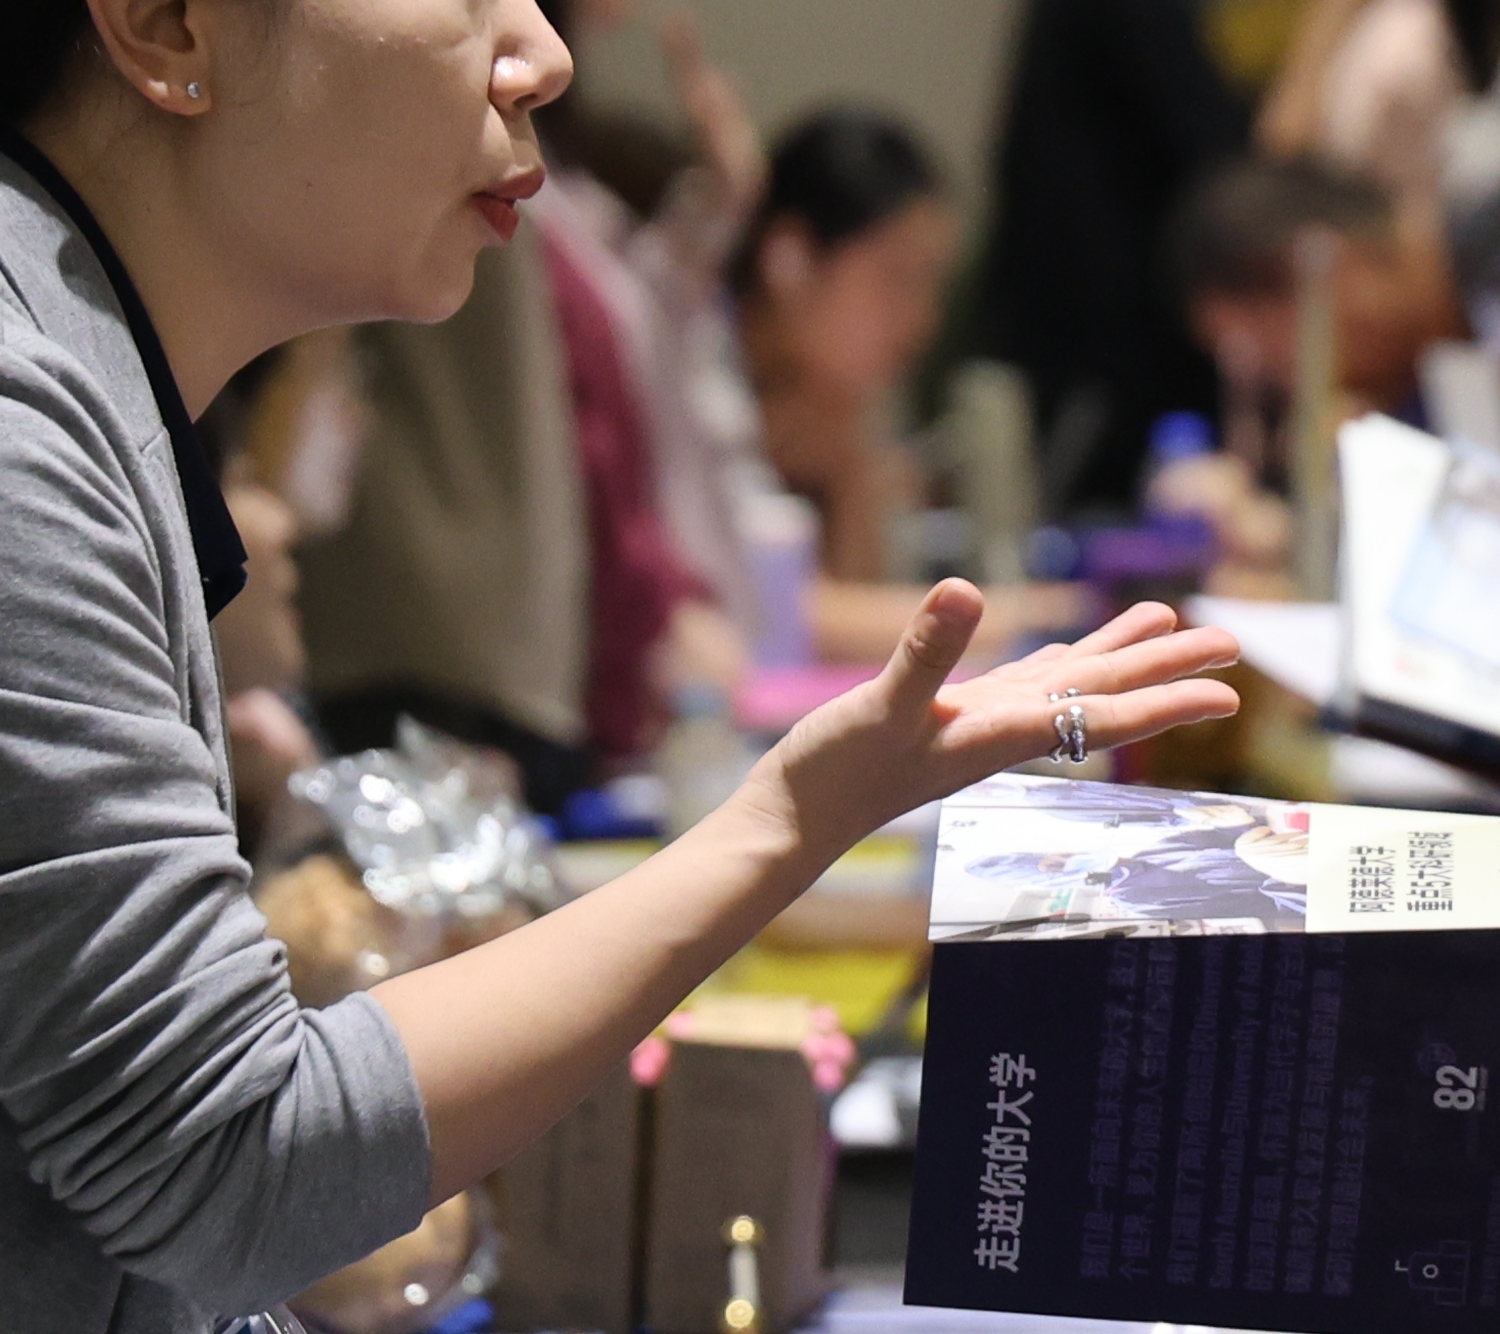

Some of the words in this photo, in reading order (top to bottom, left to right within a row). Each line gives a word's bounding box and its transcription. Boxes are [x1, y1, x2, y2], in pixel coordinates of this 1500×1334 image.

[1348, 846, 1396, 913] 阿德莱德大学
[1406, 831, 1454, 911] 重点5大科研领域
[1432, 1063, 1478, 1111] 82
[973, 1052, 1036, 1273] 走进你的大学
